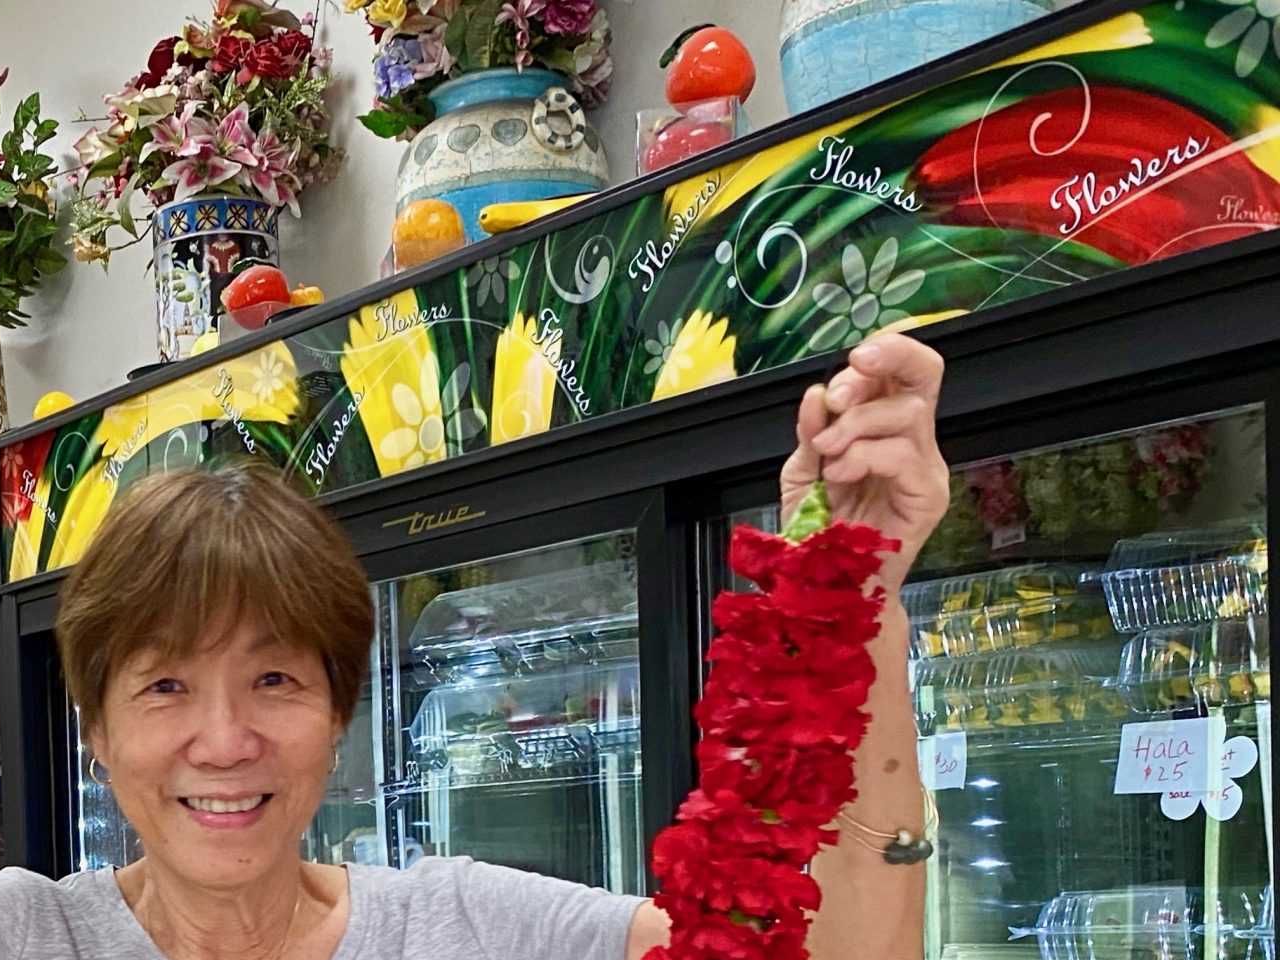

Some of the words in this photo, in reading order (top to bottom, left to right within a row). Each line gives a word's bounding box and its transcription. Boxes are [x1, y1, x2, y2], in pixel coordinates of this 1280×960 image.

[810, 134, 923, 212] Flowers
[1050, 136, 1211, 234] Flowers
[1216, 195, 1280, 221] Flower
[628, 173, 721, 293] Flowers
[374, 302, 452, 342] Flowers
[530, 308, 592, 416] Flowers
[212, 367, 256, 454] Flowers
[306, 385, 365, 485] Flowers
[100, 417, 148, 491] Flowers
[20, 469, 58, 524] Flowers
[382, 505, 486, 534] true
[1144, 761, 1188, 782] $25
